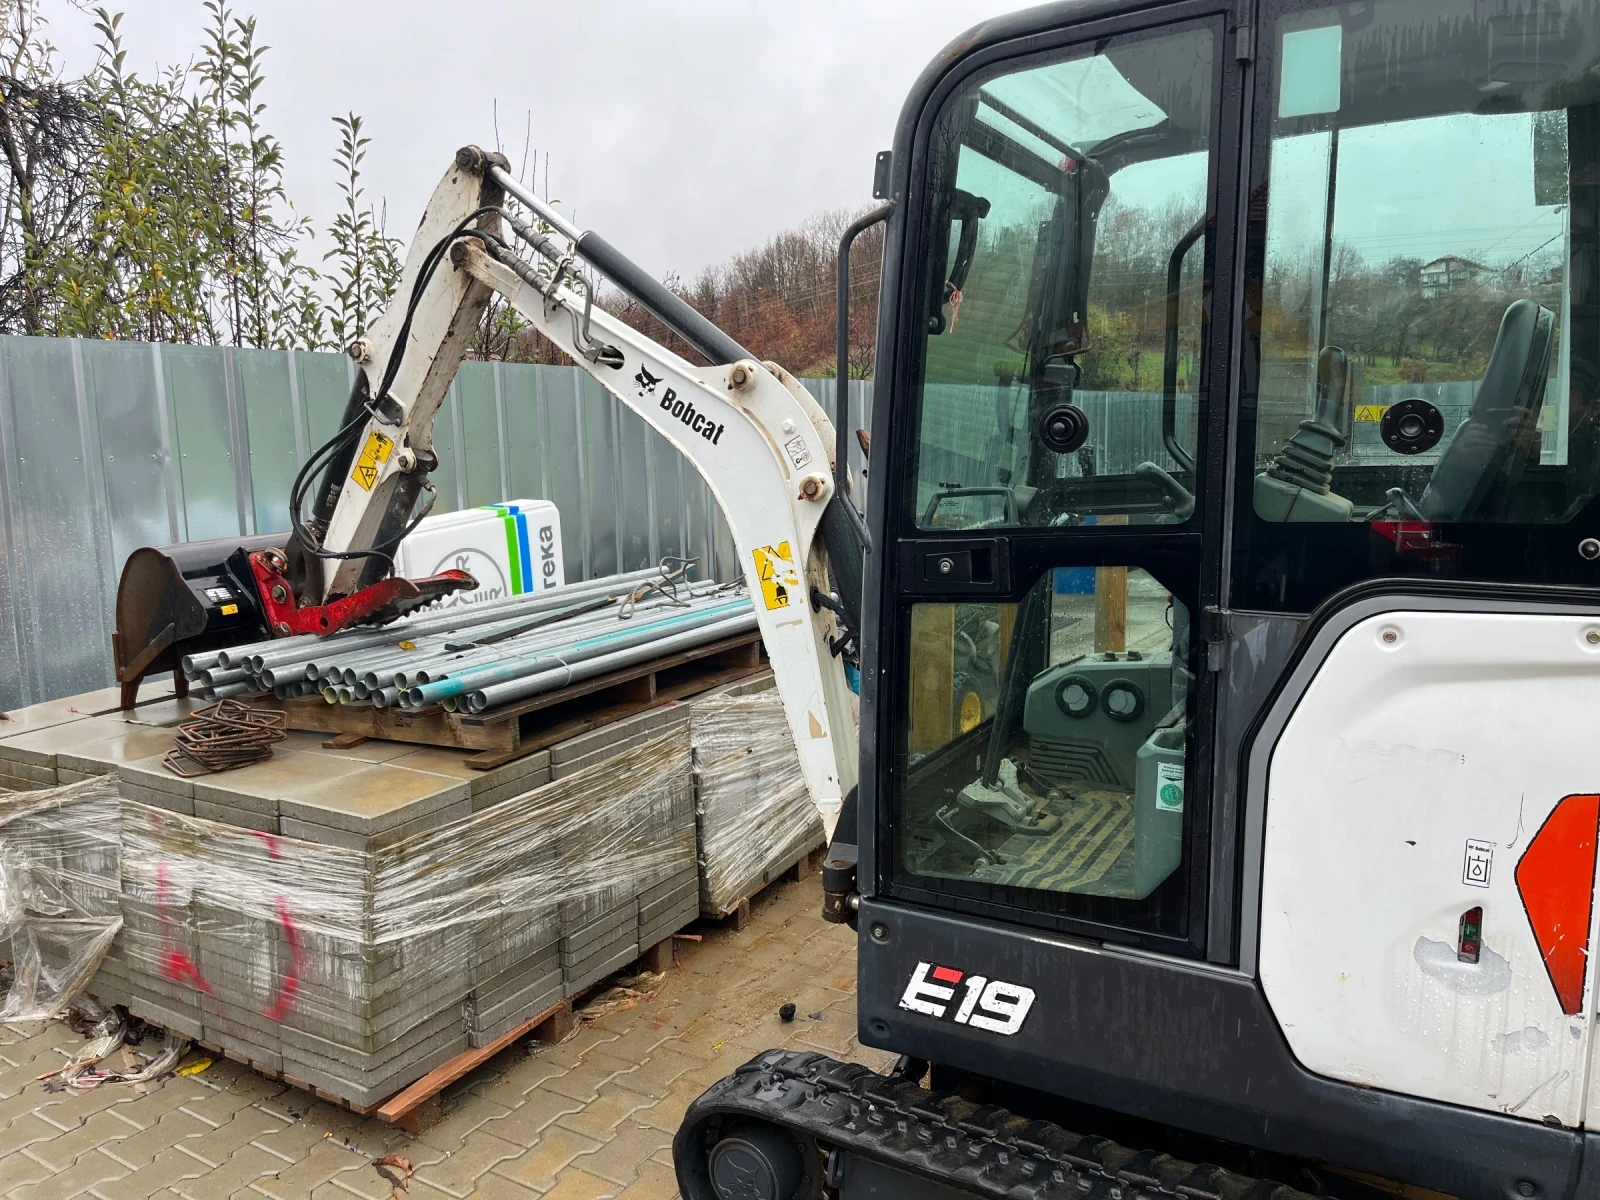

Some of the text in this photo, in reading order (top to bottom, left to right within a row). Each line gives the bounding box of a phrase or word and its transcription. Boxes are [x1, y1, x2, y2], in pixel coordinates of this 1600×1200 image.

[660, 387, 724, 445] Bobcat
[539, 525, 557, 589] тека
[898, 961, 1036, 1035] E19
